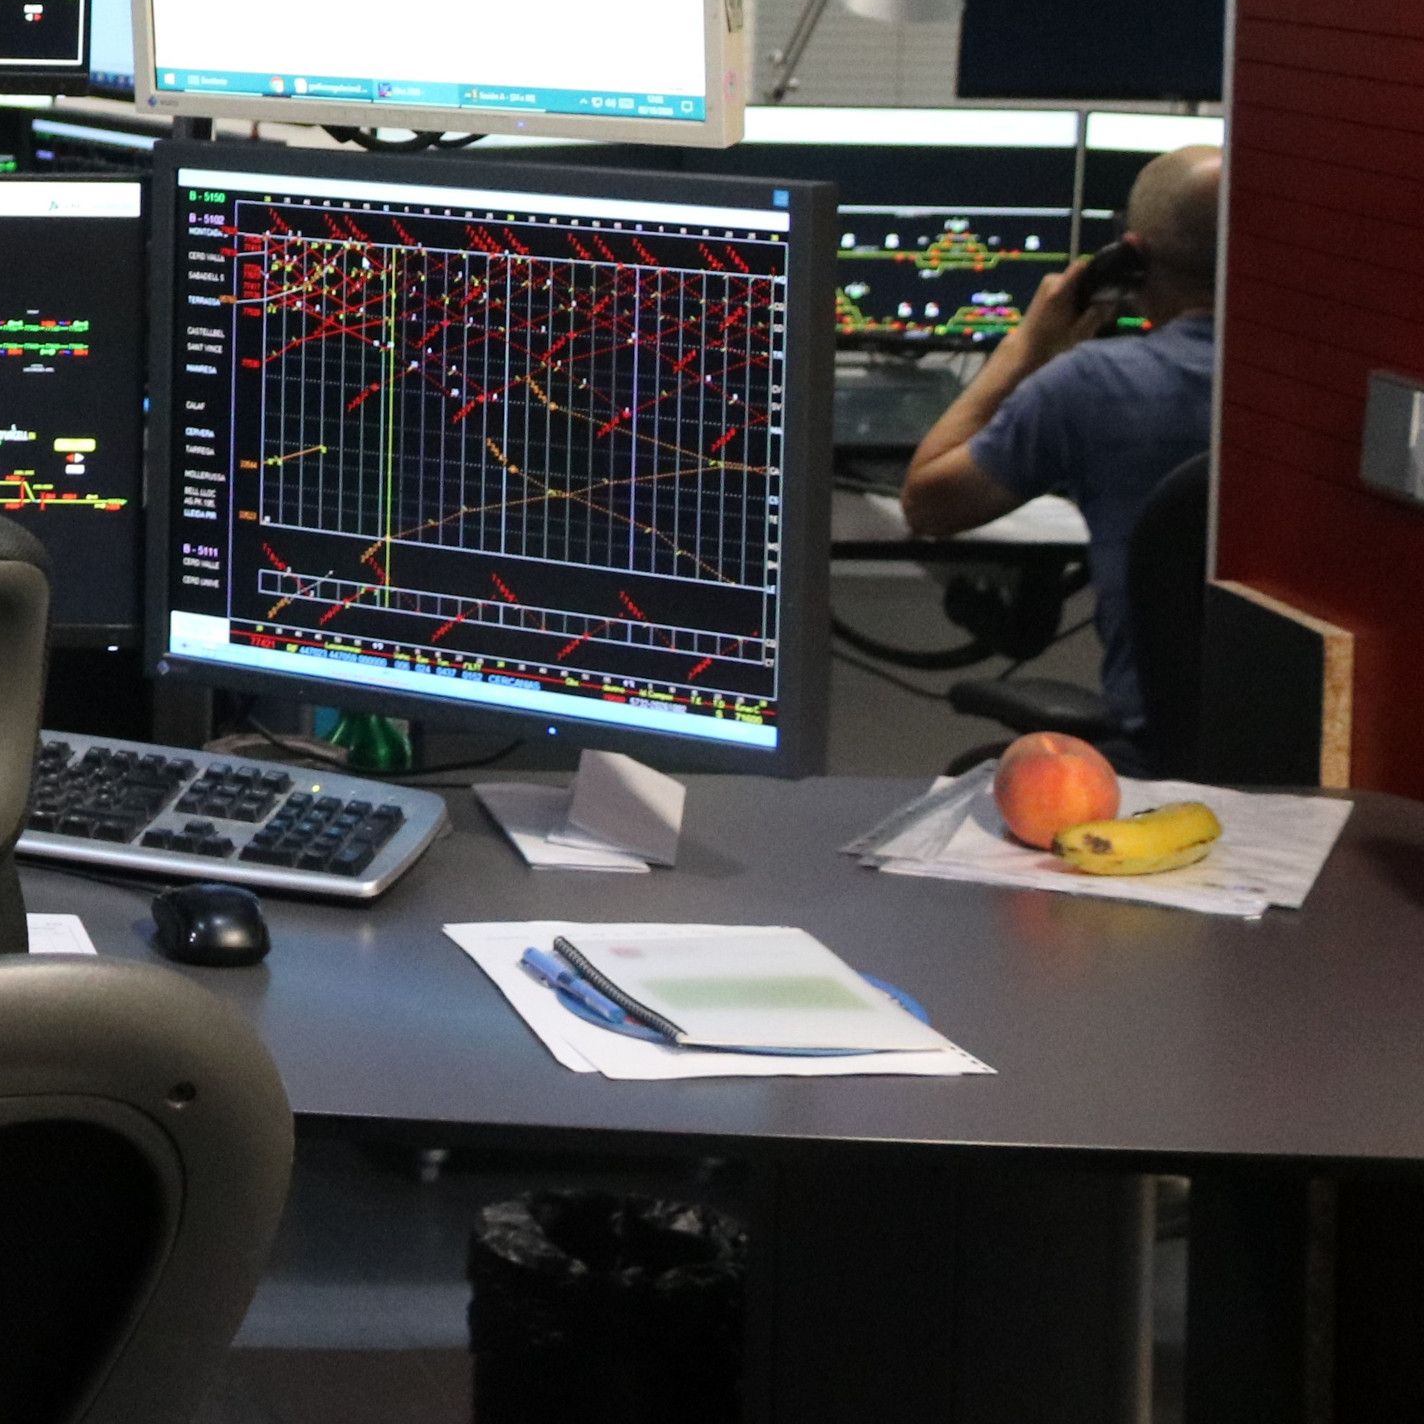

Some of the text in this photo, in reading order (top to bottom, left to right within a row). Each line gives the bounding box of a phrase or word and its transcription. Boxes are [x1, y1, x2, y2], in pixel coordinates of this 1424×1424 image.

[185, 400, 206, 410] CALAF
[184, 470, 226, 482] MOLLERUSSA
[197, 545, 218, 557] 5111
